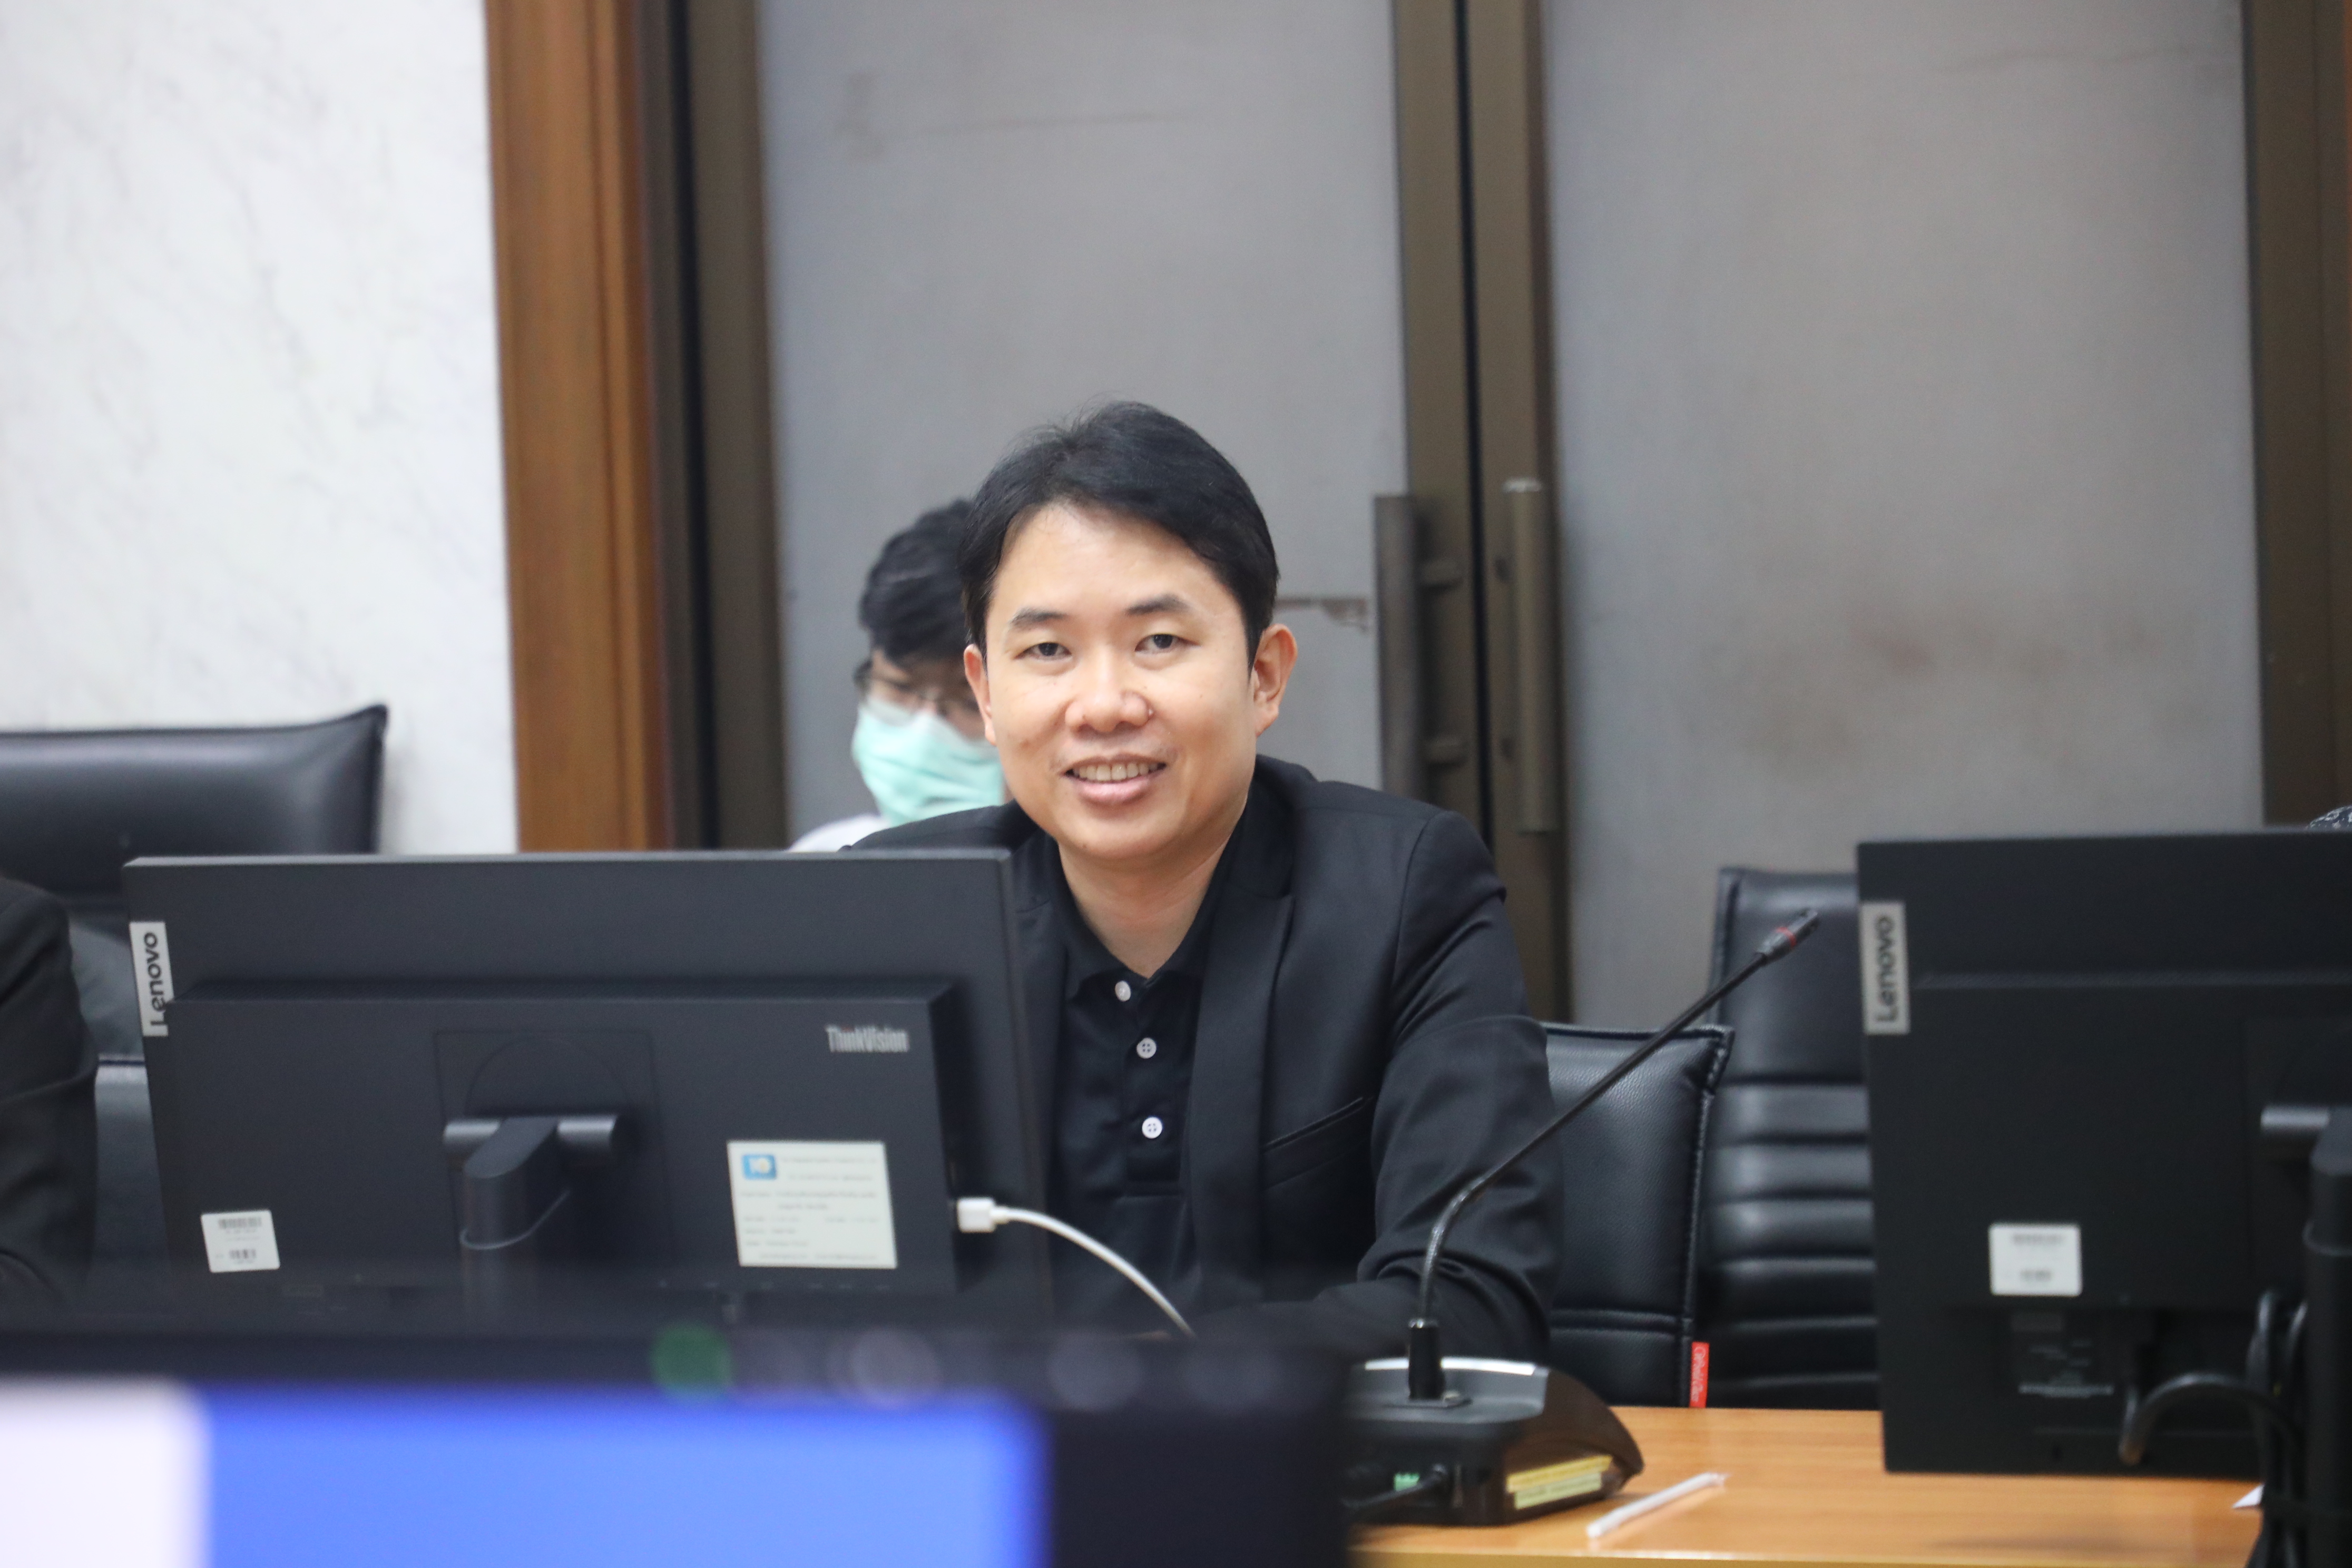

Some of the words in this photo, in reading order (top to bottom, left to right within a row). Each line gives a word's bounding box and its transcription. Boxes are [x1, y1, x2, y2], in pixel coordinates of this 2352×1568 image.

[143, 931, 168, 1027] Lenovo
[1875, 915, 1899, 1022] Lenovo
[825, 1024, 910, 1053] ThinkVision
